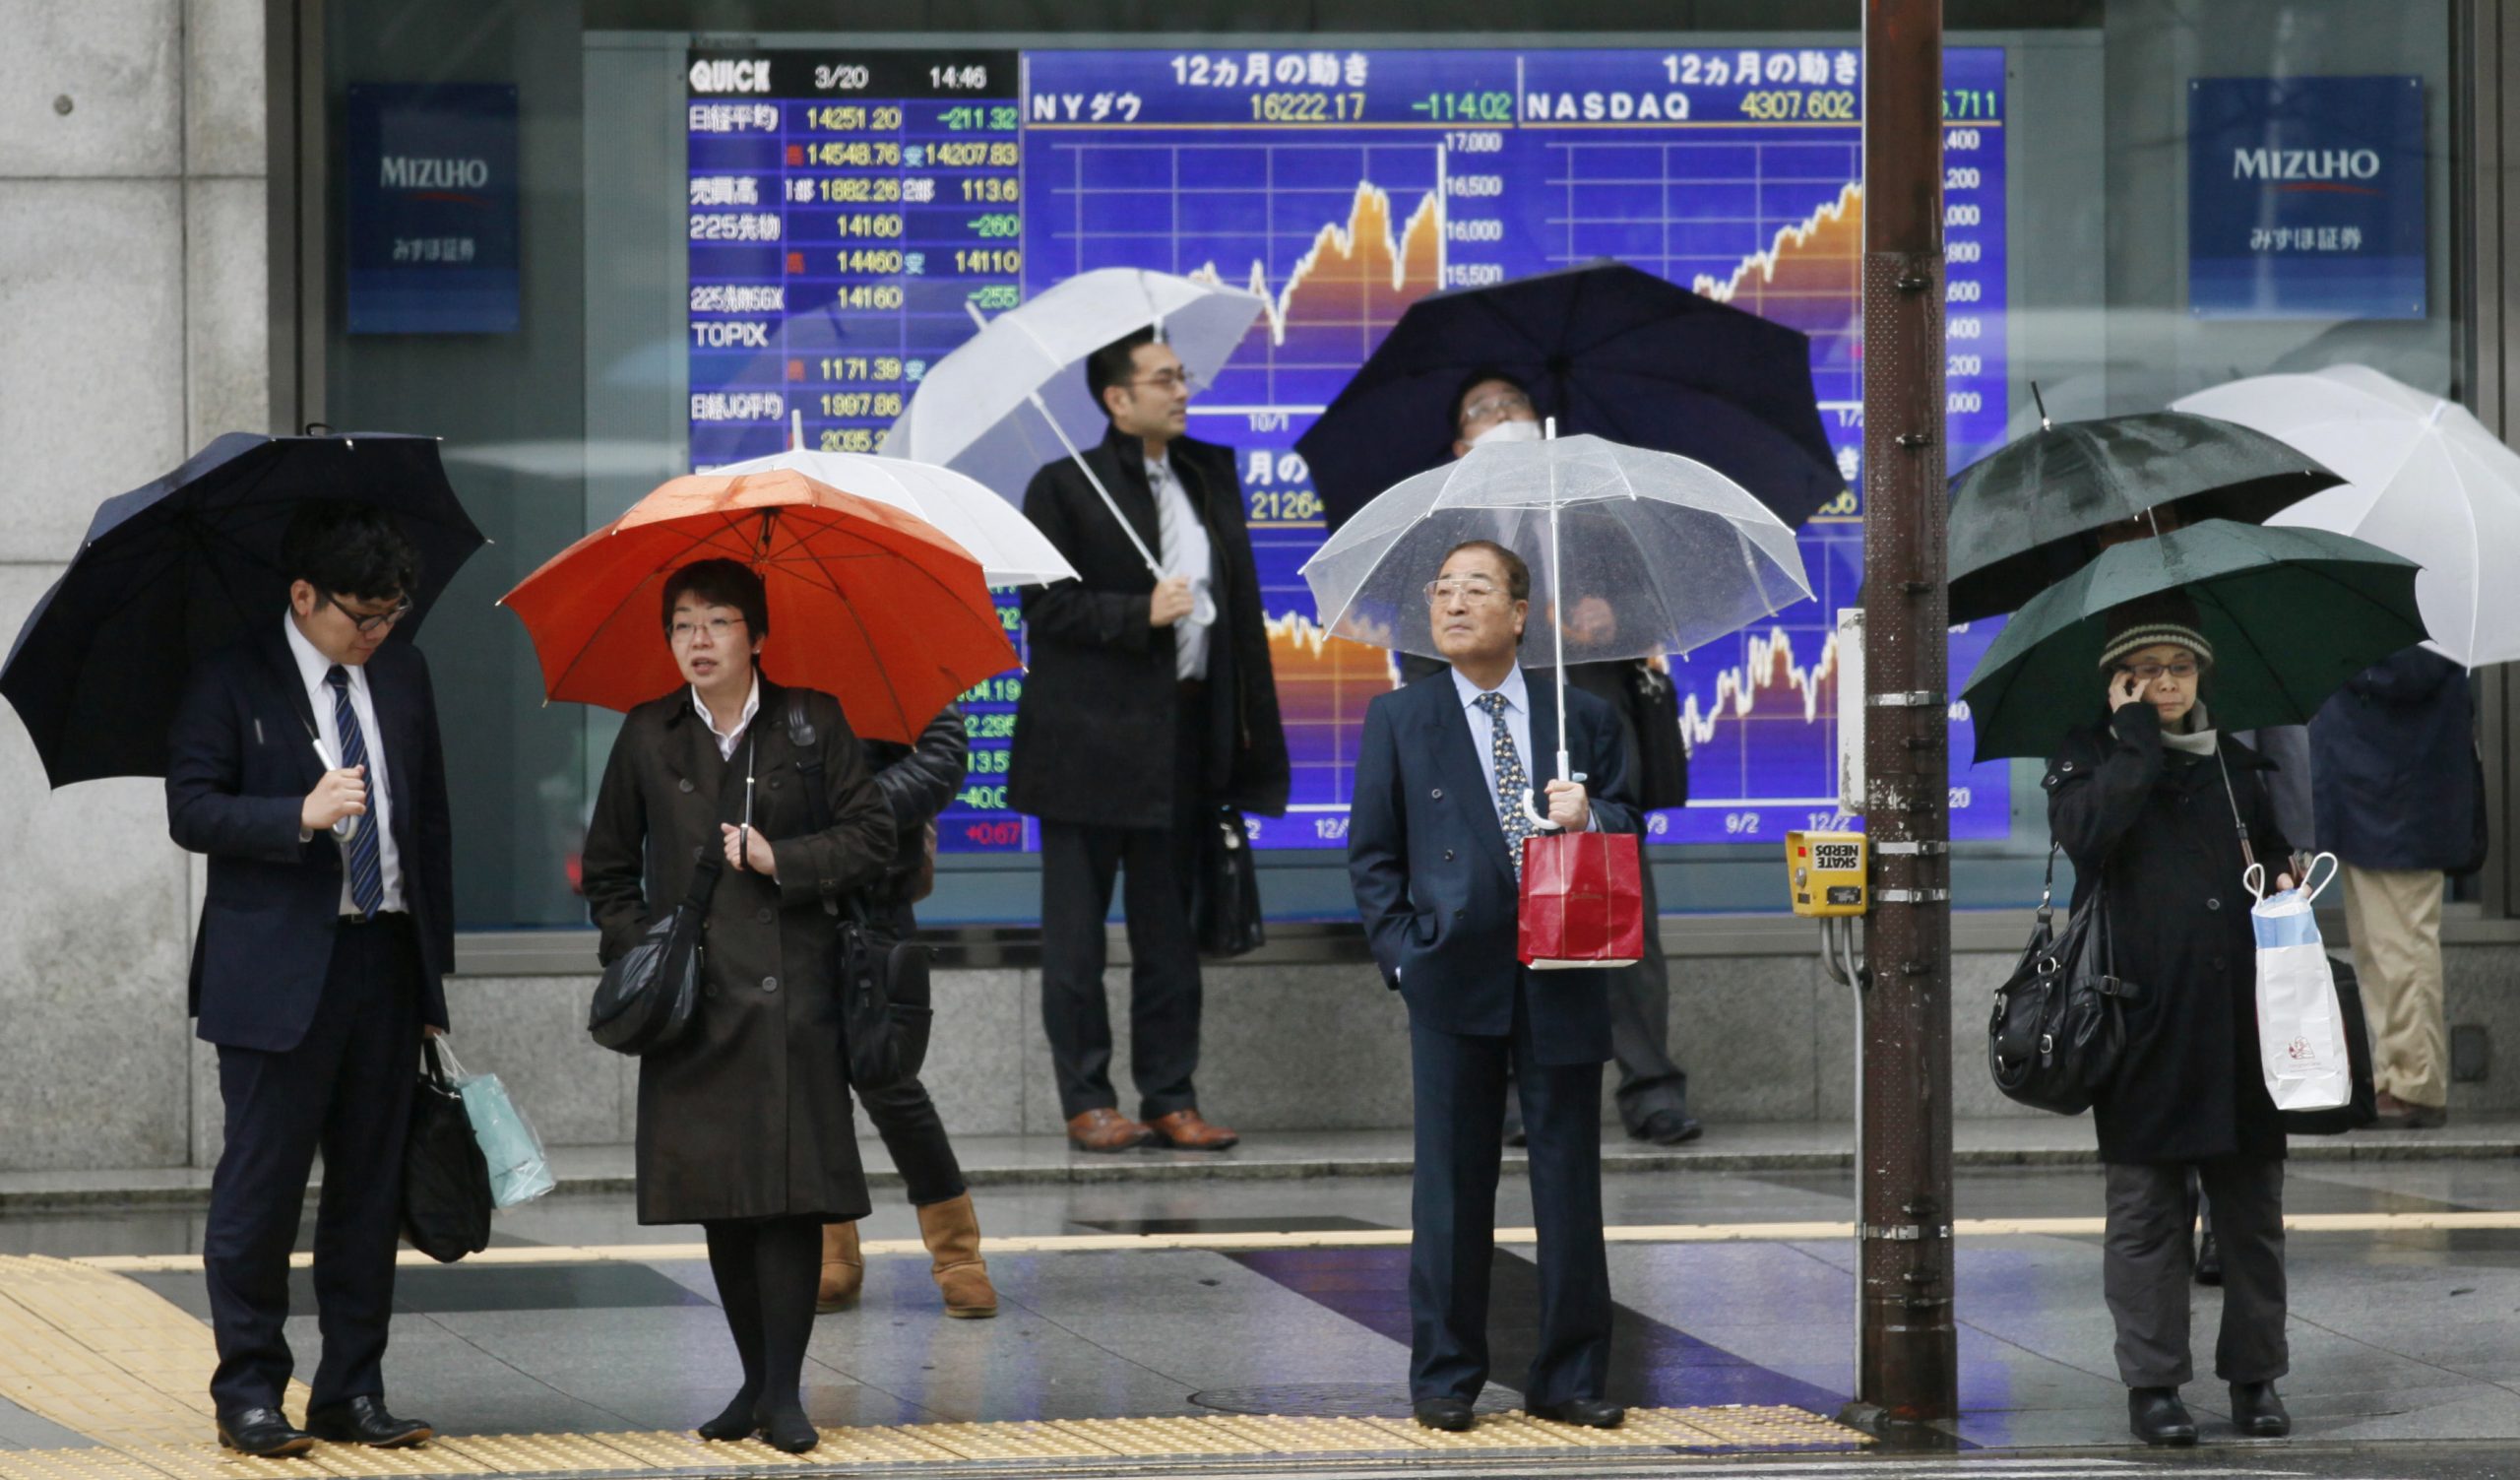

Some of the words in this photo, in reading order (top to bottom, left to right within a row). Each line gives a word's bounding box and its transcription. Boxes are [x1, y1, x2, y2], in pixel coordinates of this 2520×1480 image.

[690, 59, 771, 93] QUICK
[815, 65, 869, 90] 3/20
[929, 65, 987, 90] 14:46
[1033, 94, 1142, 121] NYダウ
[1251, 93, 1366, 121] 16222.17
[1413, 93, 1513, 120] -114.02
[1527, 92, 1690, 120] NASDAQ
[1740, 91, 1856, 119] 4307.602
[689, 103, 779, 133] 日経平均
[807, 106, 902, 130] 14251.20
[937, 106, 1018, 130] -211.32
[1445, 132, 1503, 154] 17,000
[380, 156, 489, 188] MIZUHO
[2233, 148, 2380, 179] MIZUHO
[1445, 177, 1503, 199] 16,500
[690, 213, 782, 241] 225先物
[838, 214, 903, 237] 14160
[967, 214, 1021, 237] -260
[1445, 222, 1503, 243] 16,000
[2250, 226, 2362, 251] みずほ証券
[838, 250, 903, 273] 14460
[955, 250, 1021, 273] 14110
[838, 286, 904, 309] 14160
[968, 285, 1020, 309] -255
[691, 321, 769, 348] TOPIX
[821, 357, 902, 380] 1171.39
[1725, 811, 1761, 834] 9/2
[1815, 845, 1859, 857] NERDS
[1817, 857, 1857, 869] SKATE
